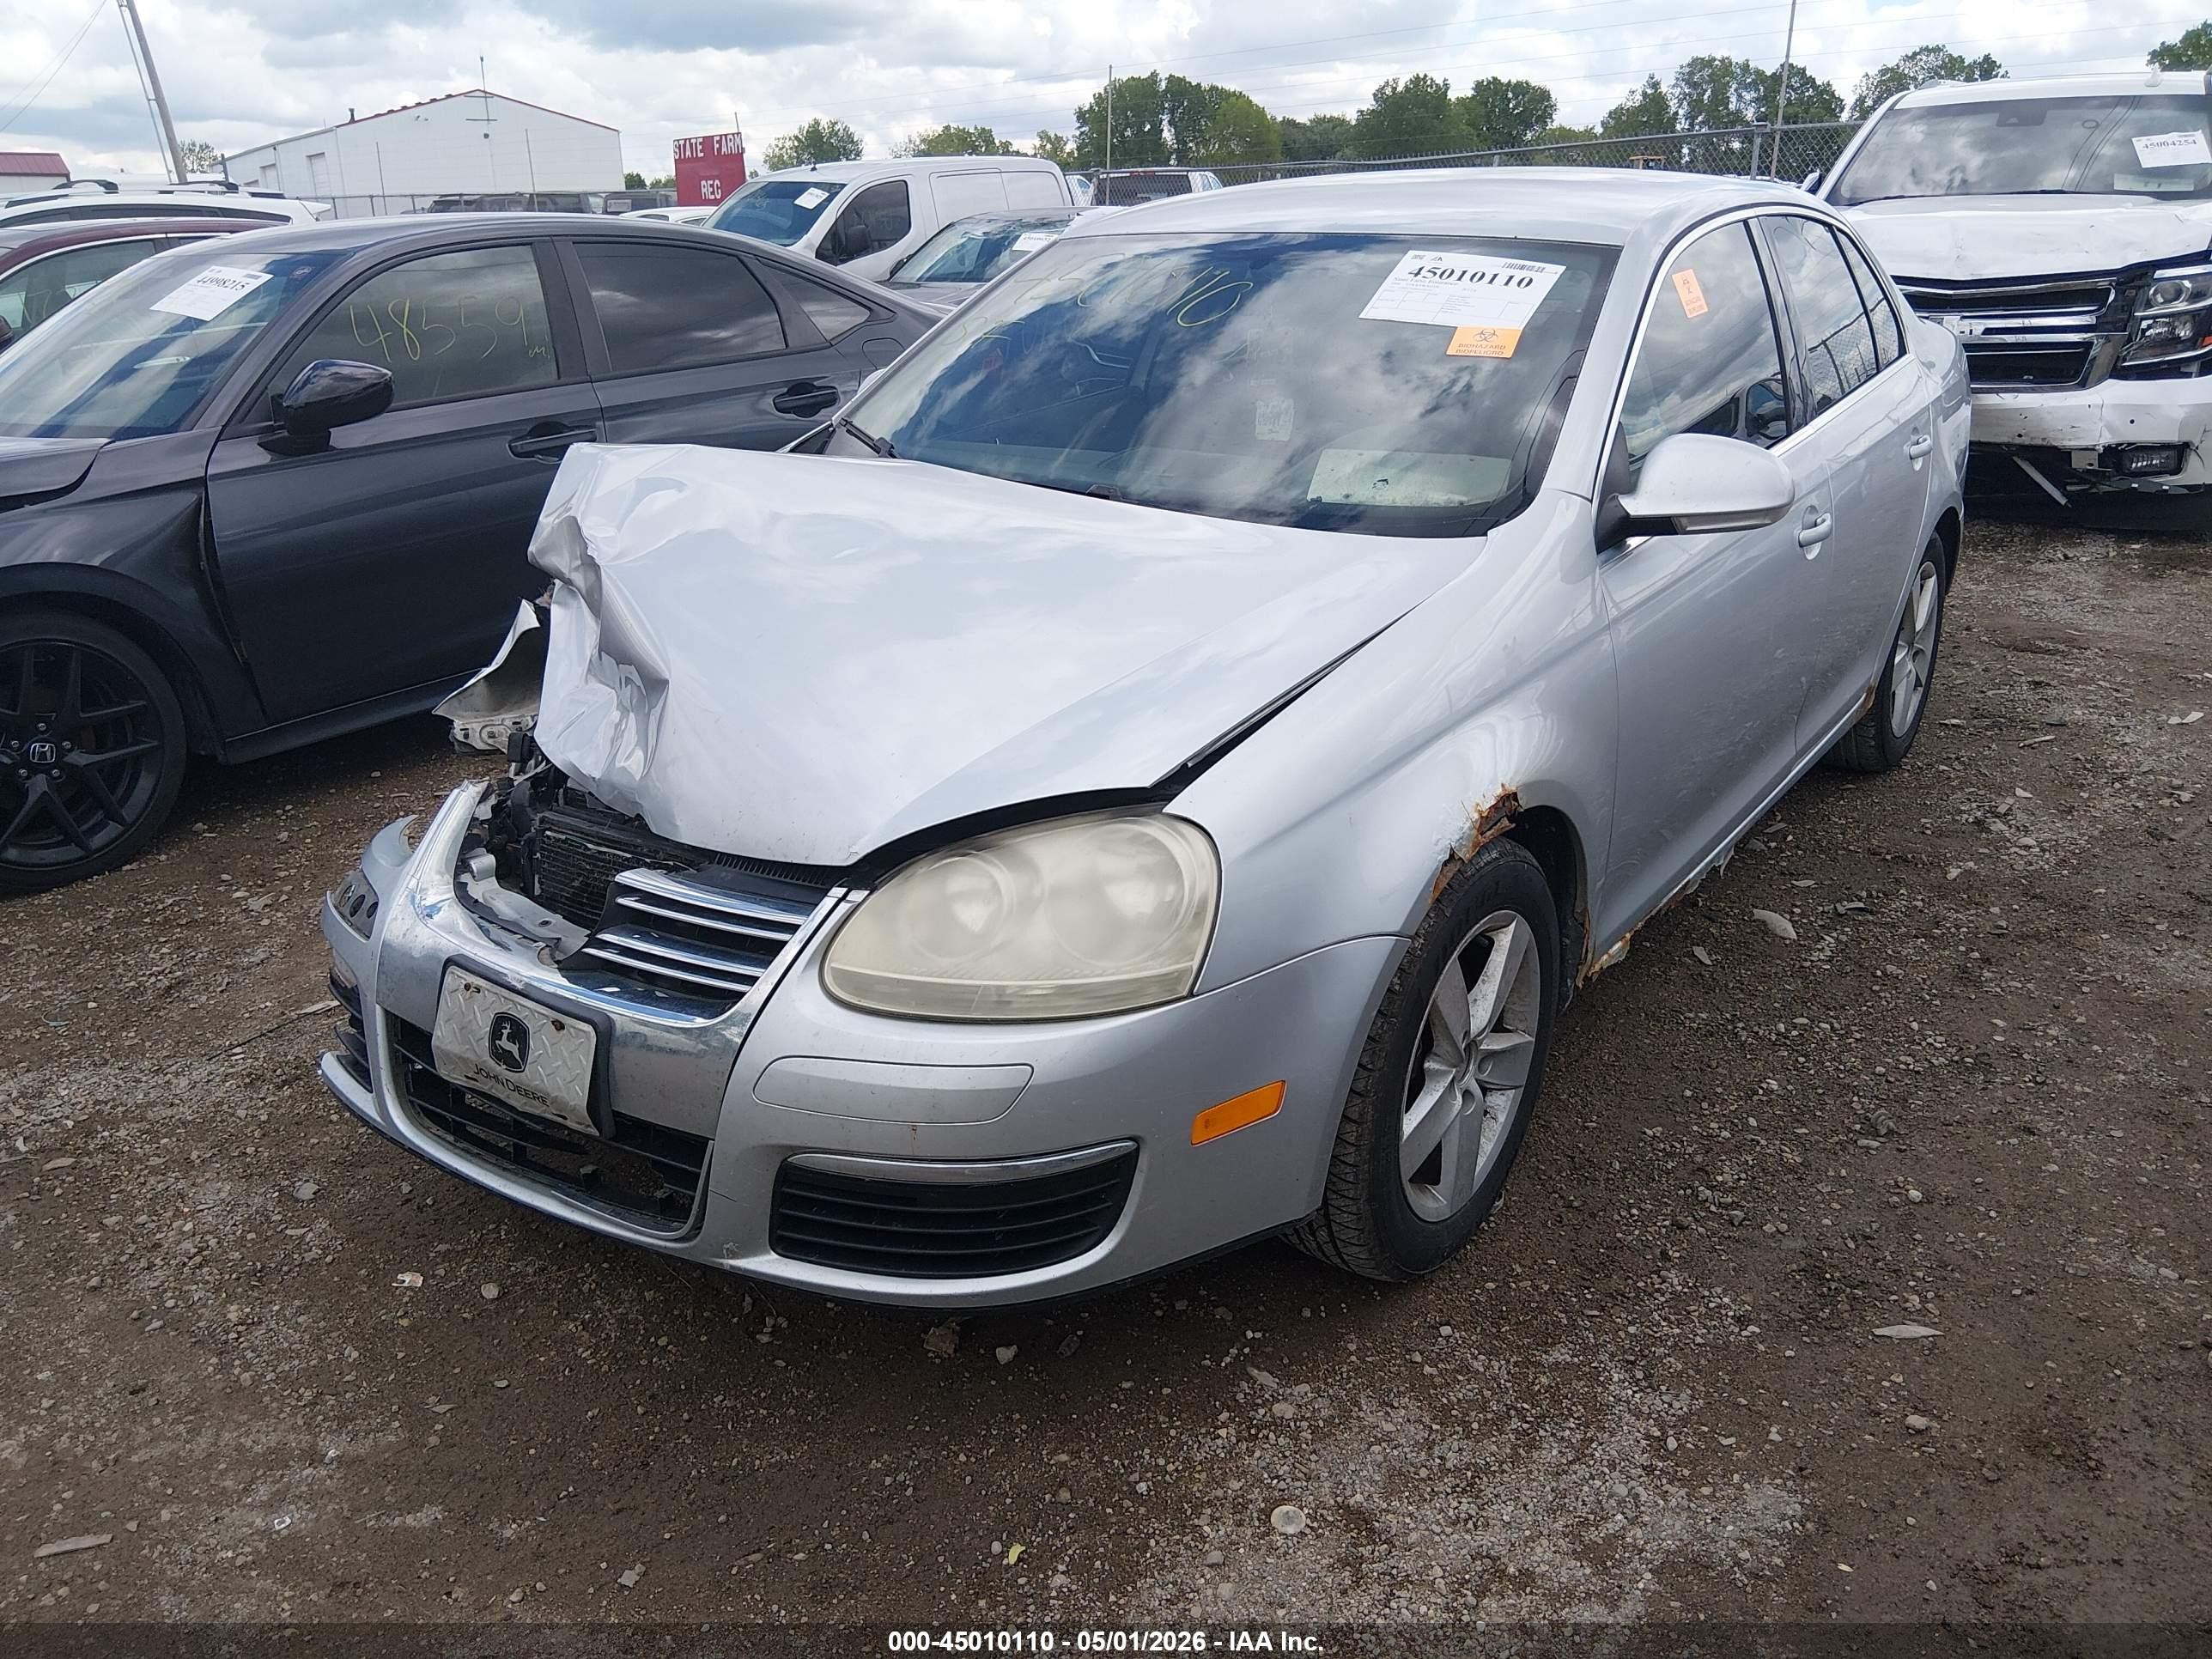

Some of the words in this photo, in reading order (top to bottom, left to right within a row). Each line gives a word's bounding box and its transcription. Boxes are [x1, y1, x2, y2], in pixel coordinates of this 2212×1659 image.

[673, 137, 704, 160] STATE
[714, 133, 742, 155] FARM
[197, 275, 250, 291] 44998215
[1407, 264, 1534, 289] 45010110
[349, 295, 528, 363] 48559
[473, 1063, 506, 1089] JOHN
[505, 1078, 550, 1108] DEERE
